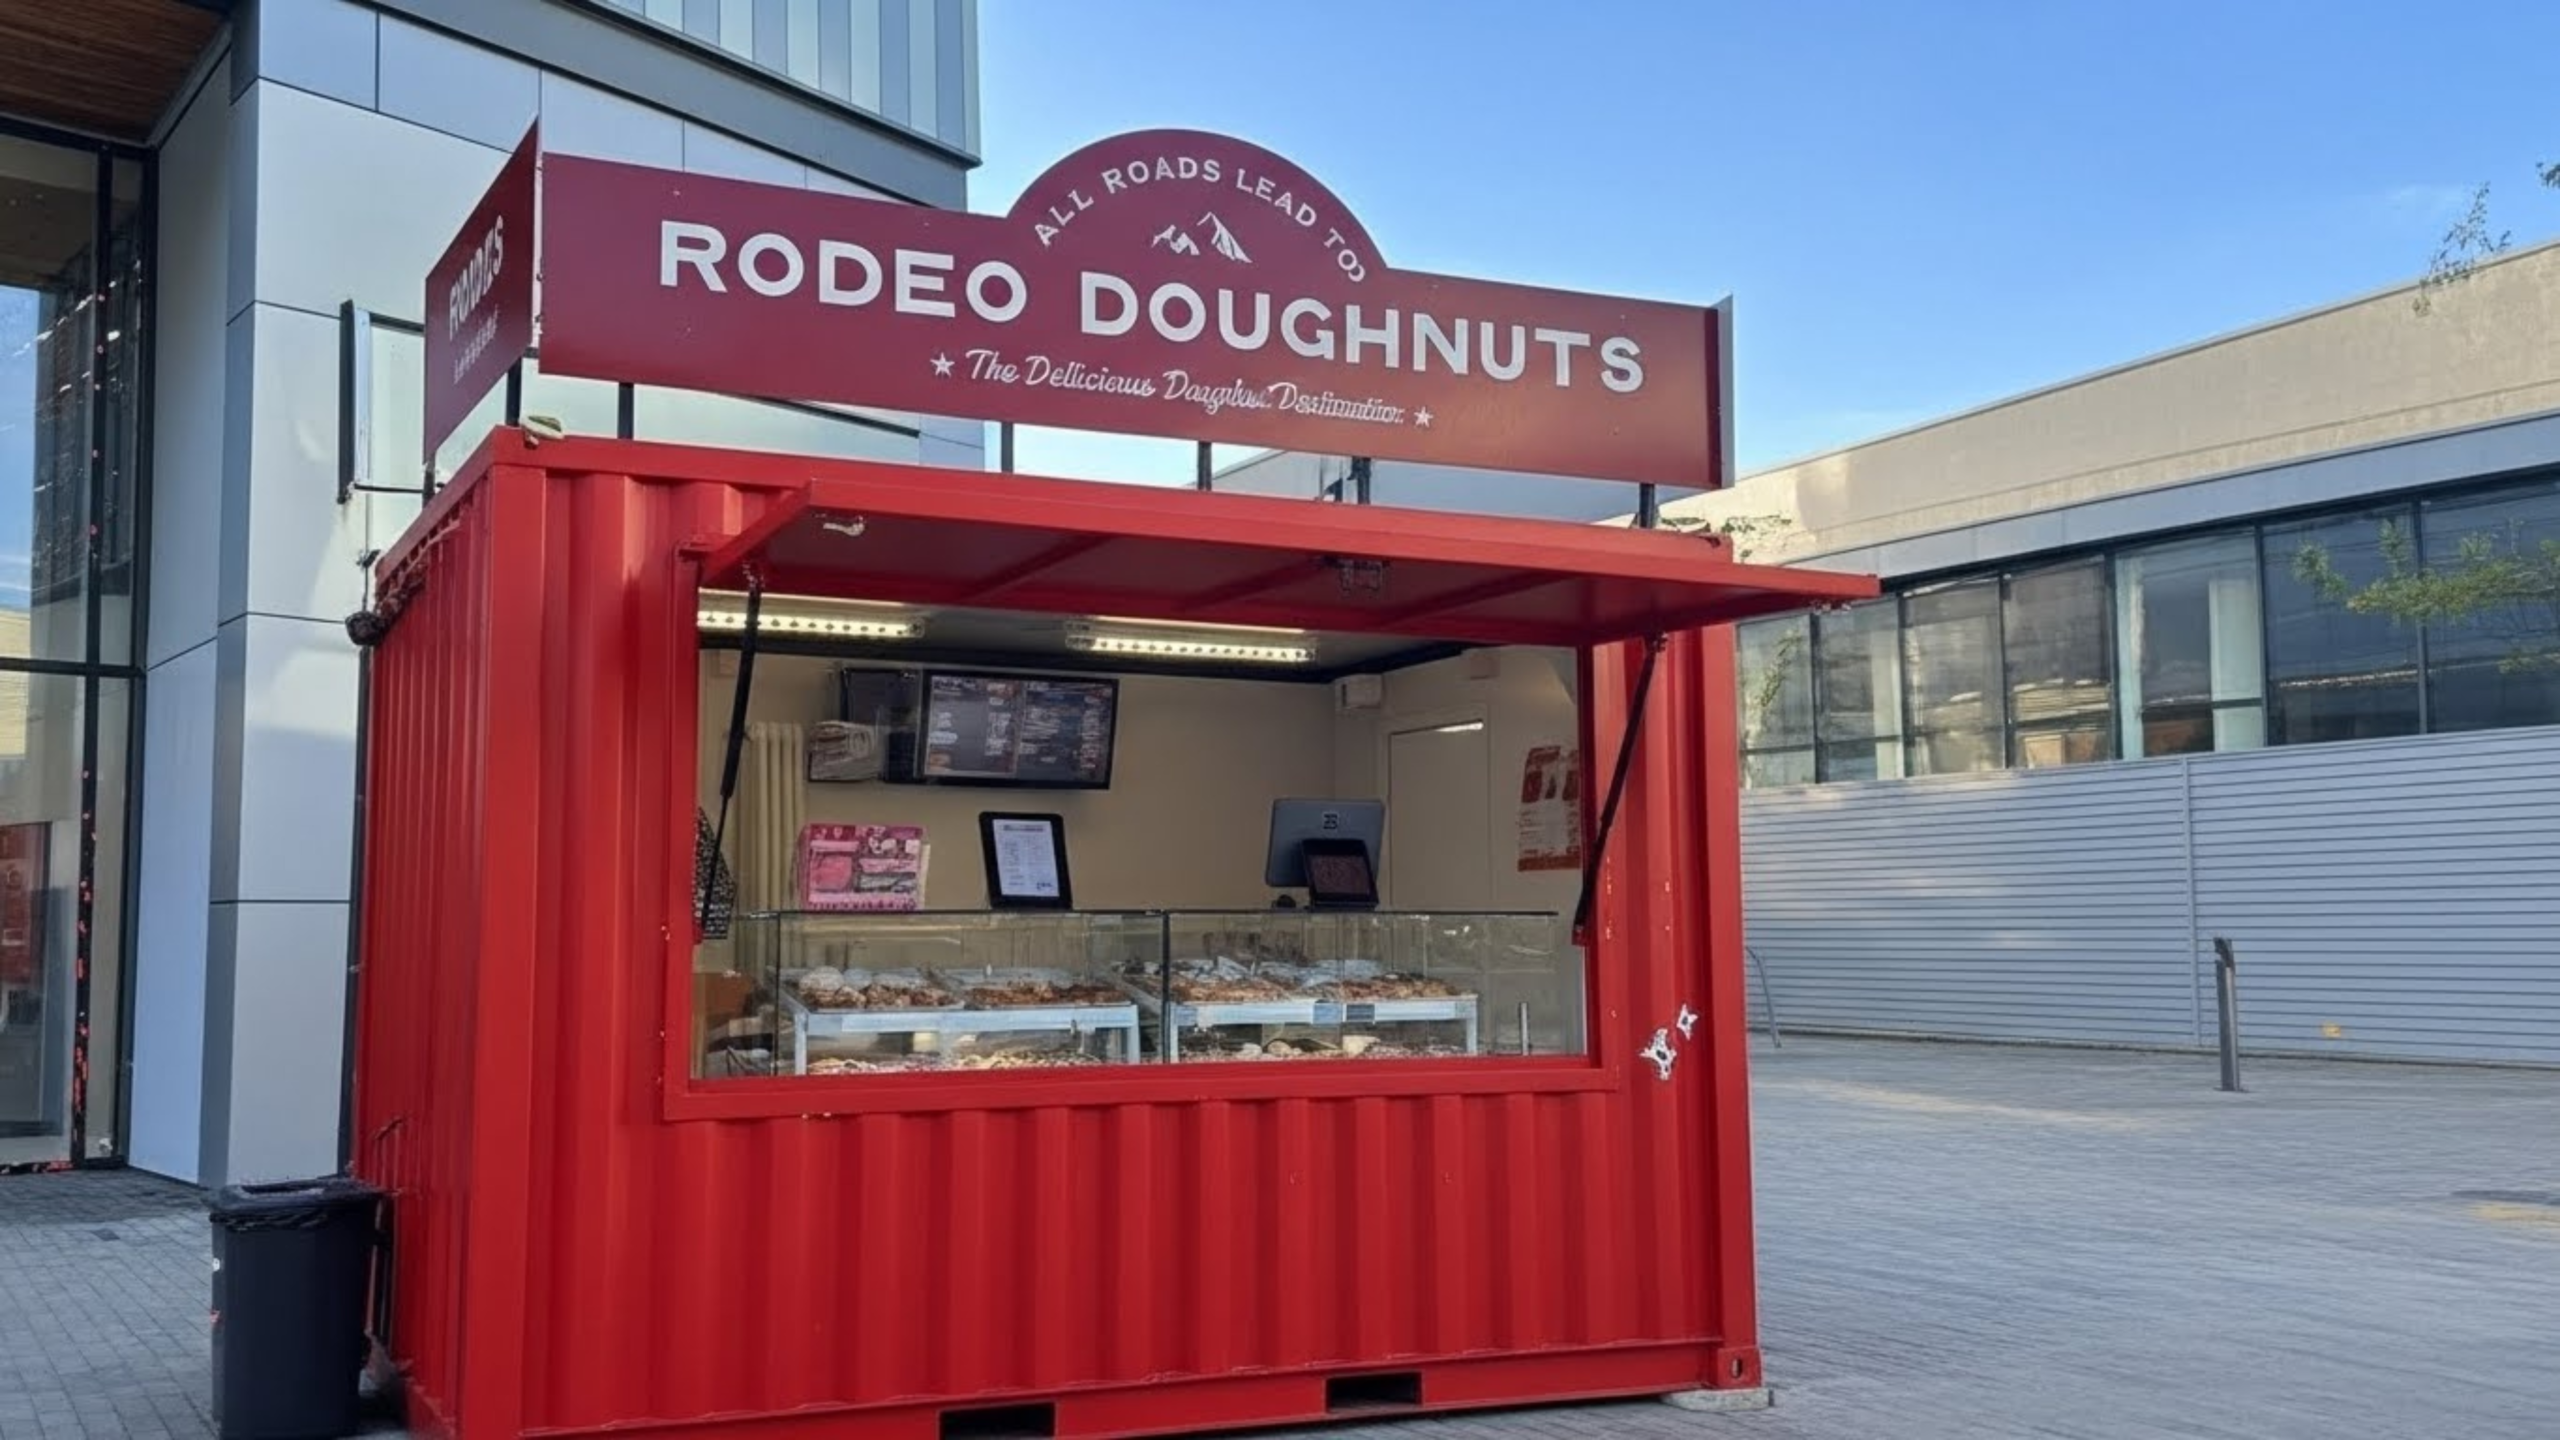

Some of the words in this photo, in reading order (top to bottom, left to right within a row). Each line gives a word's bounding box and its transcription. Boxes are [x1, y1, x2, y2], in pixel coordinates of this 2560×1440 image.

[1034, 189, 1094, 246] ALL
[1101, 156, 1221, 194] ROADS
[1236, 168, 1317, 228] LEAD
[660, 220, 1027, 322] RODEO
[1080, 271, 1644, 392] DOUGHNUTS
[965, 349, 1020, 384] The
